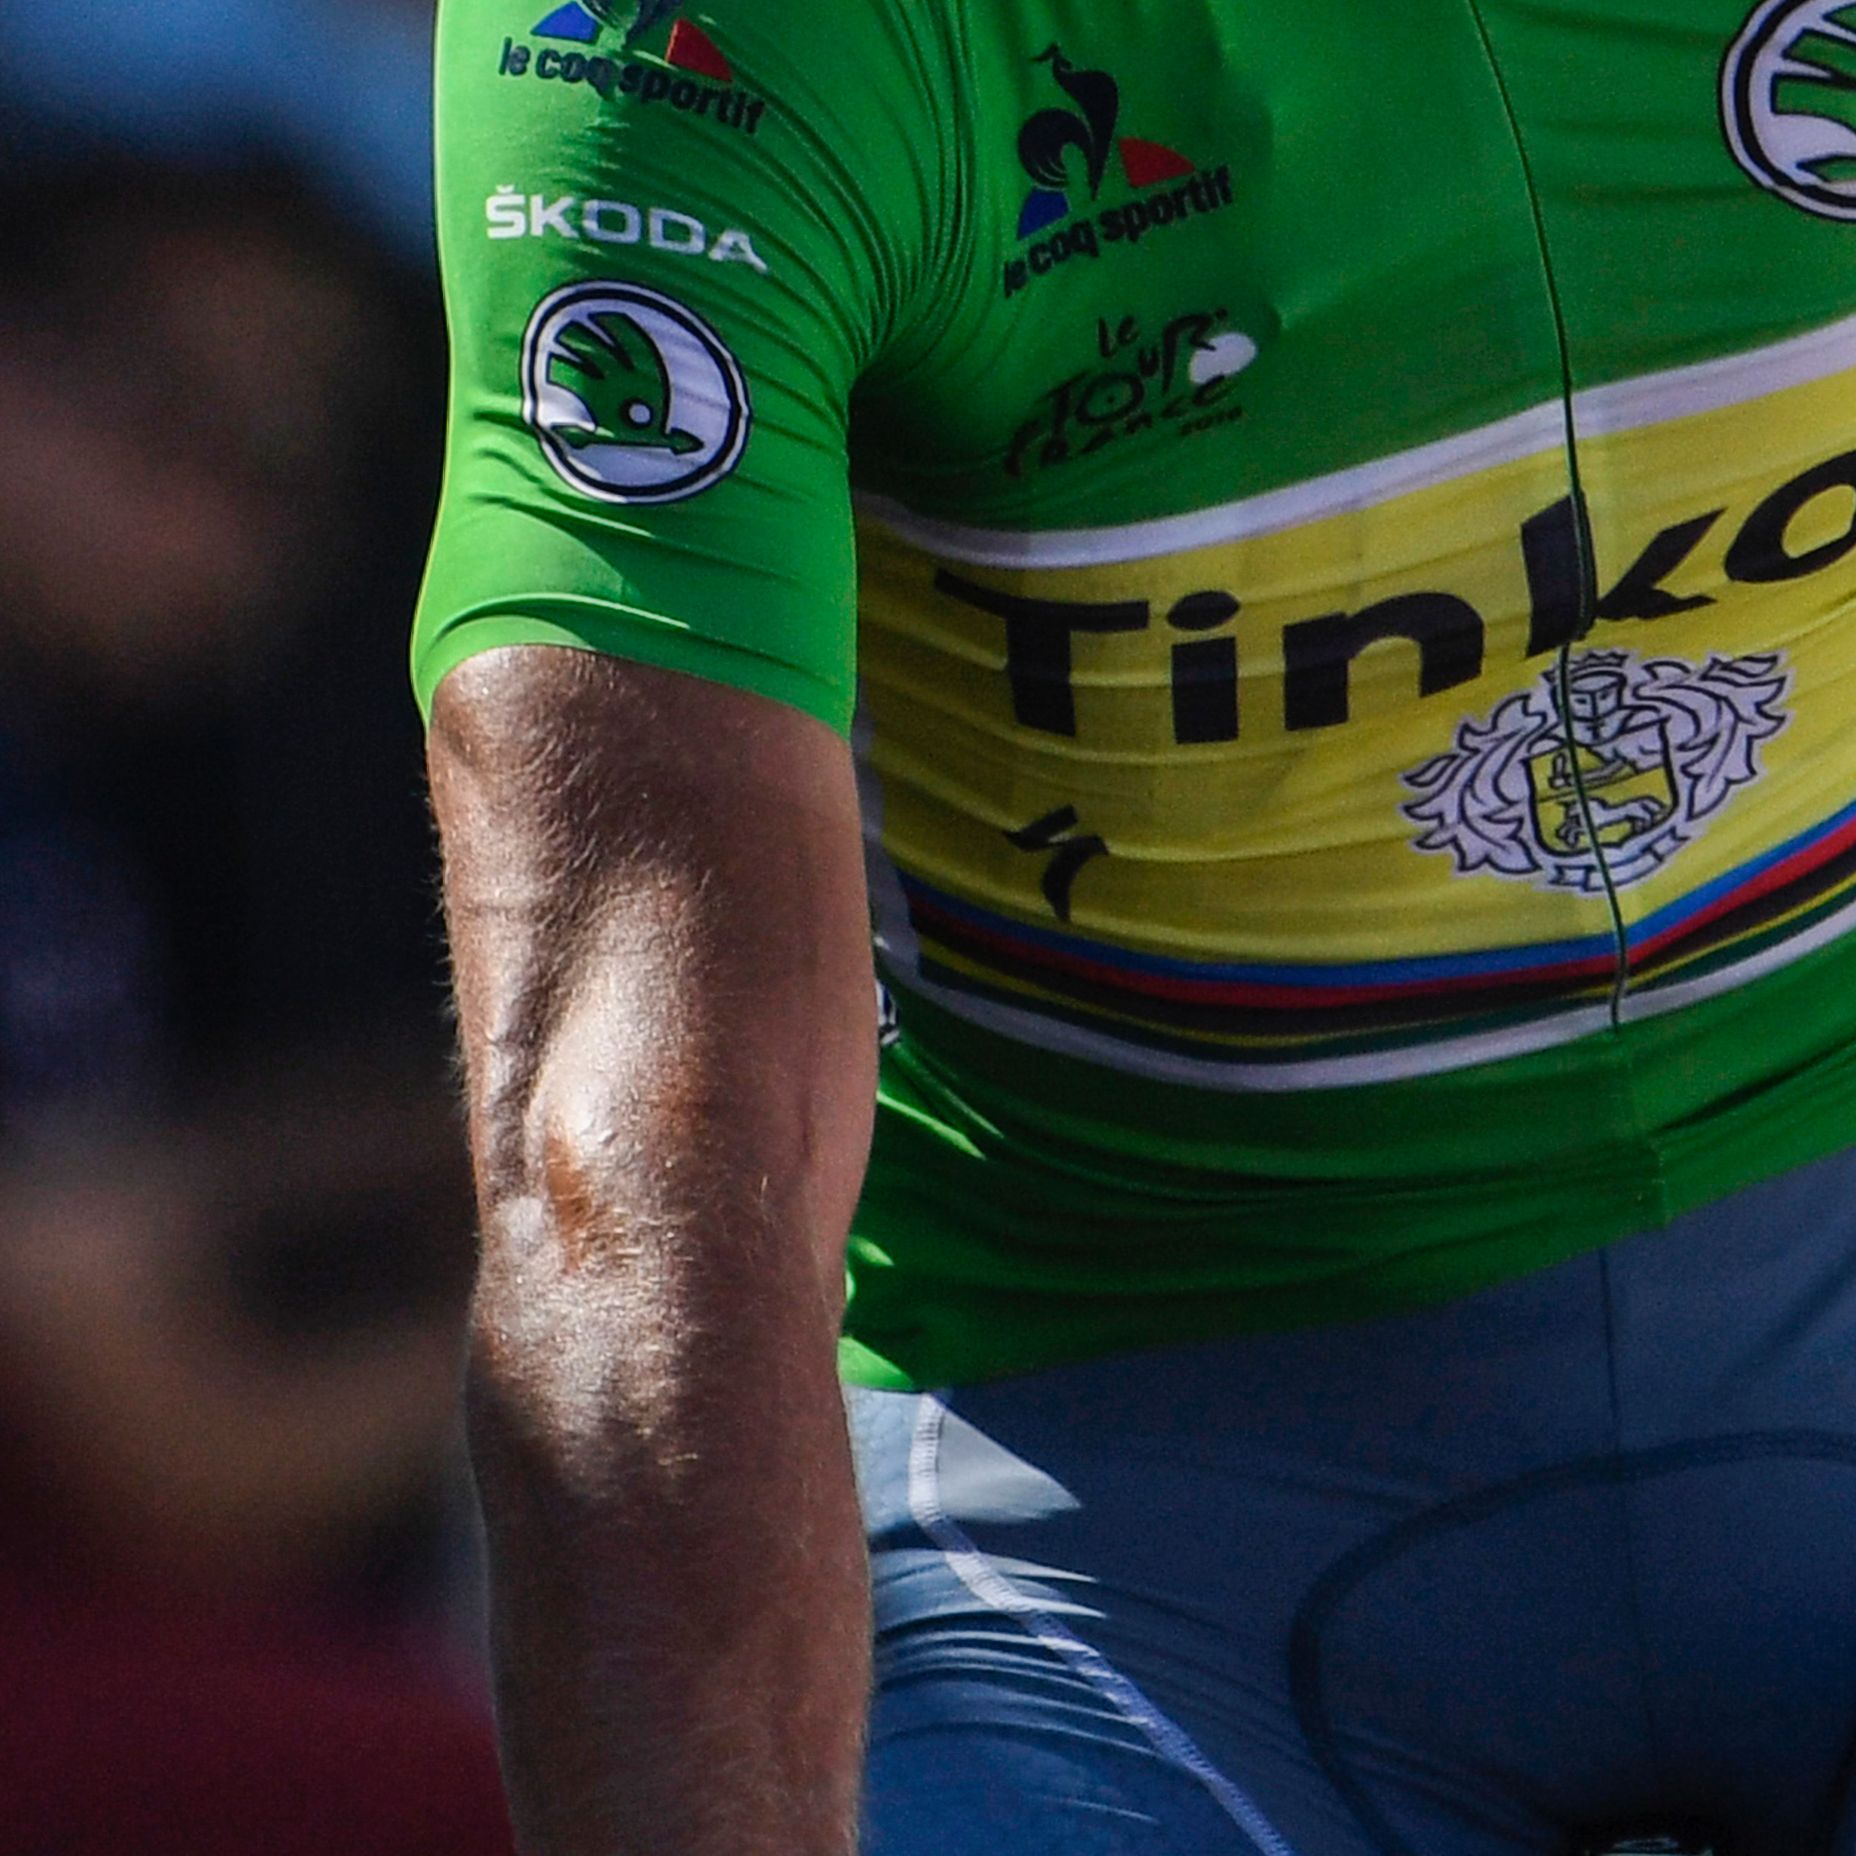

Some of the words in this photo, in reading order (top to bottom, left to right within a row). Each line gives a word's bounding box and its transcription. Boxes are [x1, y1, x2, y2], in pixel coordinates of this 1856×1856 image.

[498, 36, 531, 77] le
[535, 48, 618, 102] coq
[618, 62, 765, 135] sportif
[485, 184, 768, 274] ŠKODA
[1003, 259, 1028, 300] le
[1028, 219, 1100, 276] coq
[1098, 164, 1234, 244] sportif
